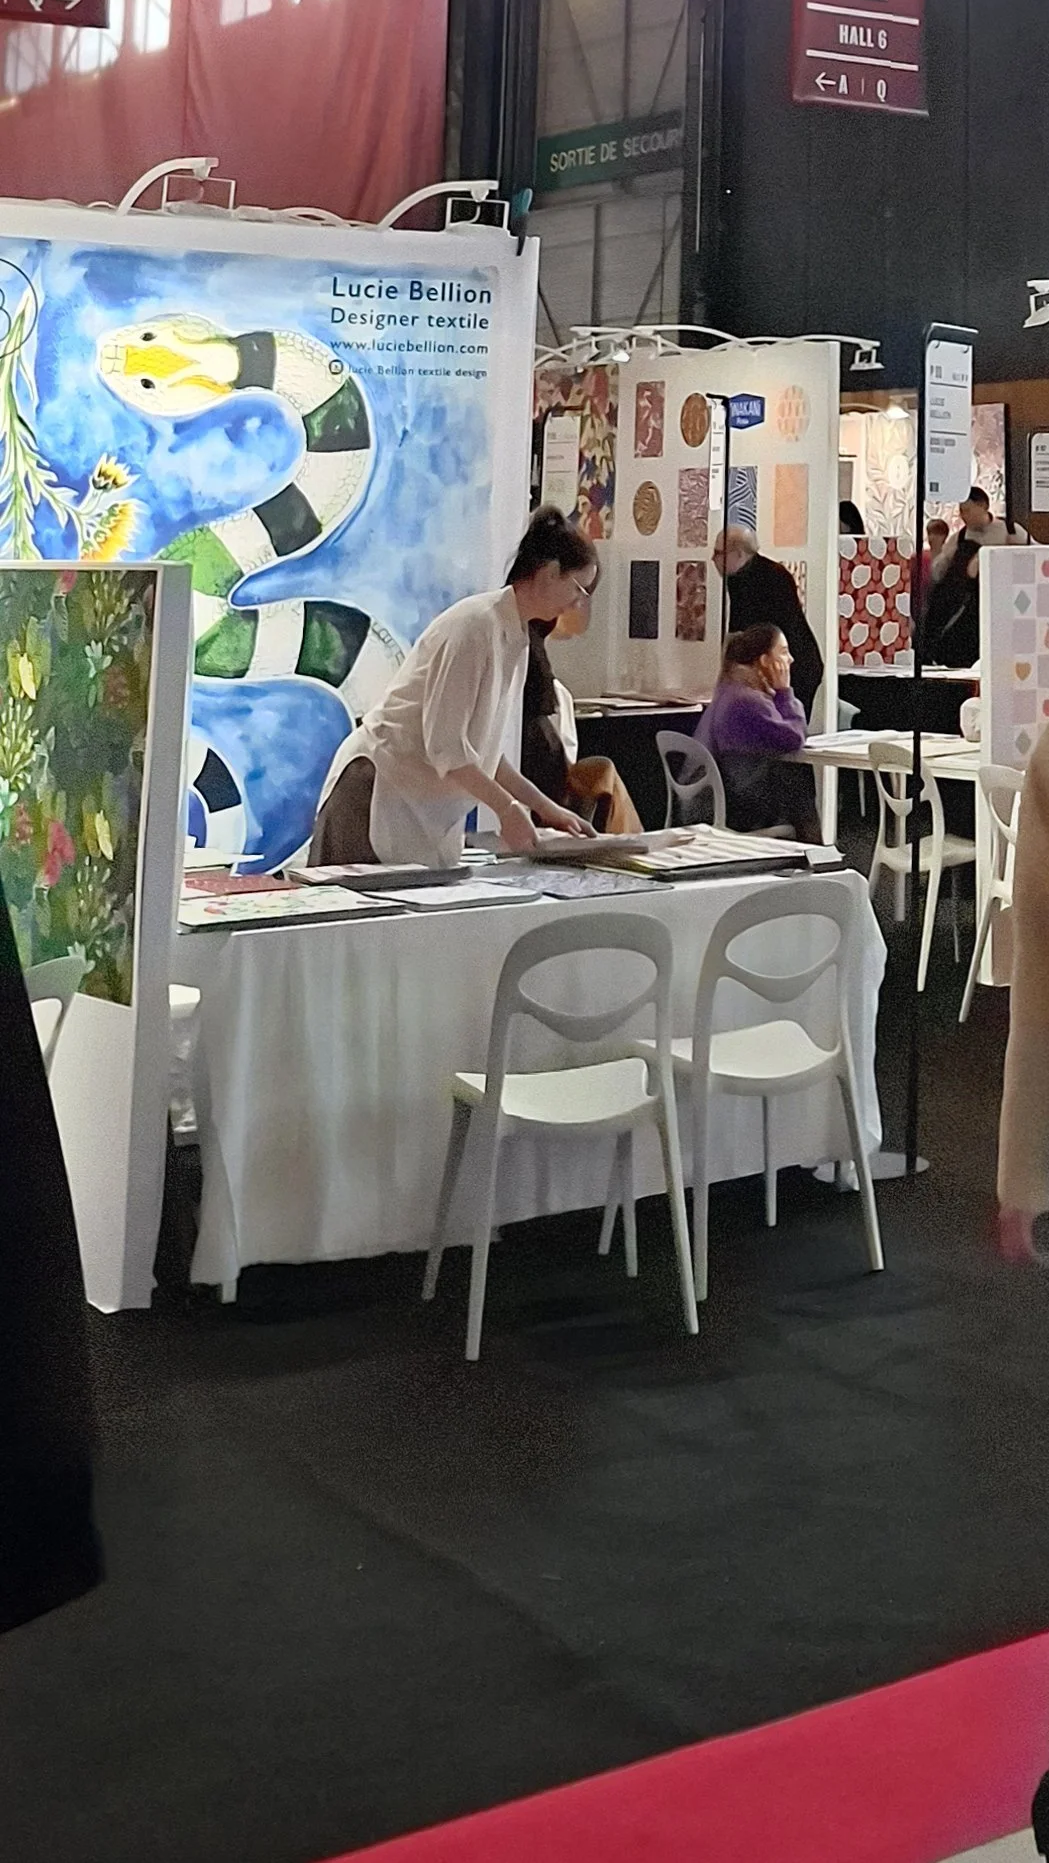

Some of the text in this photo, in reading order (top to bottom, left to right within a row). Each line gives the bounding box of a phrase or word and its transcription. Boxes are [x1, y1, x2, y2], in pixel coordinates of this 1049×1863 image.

[838, 23, 888, 50] HALL 6
[838, 74, 887, 103] A Q
[549, 145, 597, 173] SORTIE
[600, 140, 618, 163] DE
[332, 276, 492, 304] Lucie Bellion
[330, 307, 489, 330] Designer textile
[330, 339, 489, 354] www.luciebellion.com
[418, 367, 451, 377] textile
[455, 368, 488, 380] design
